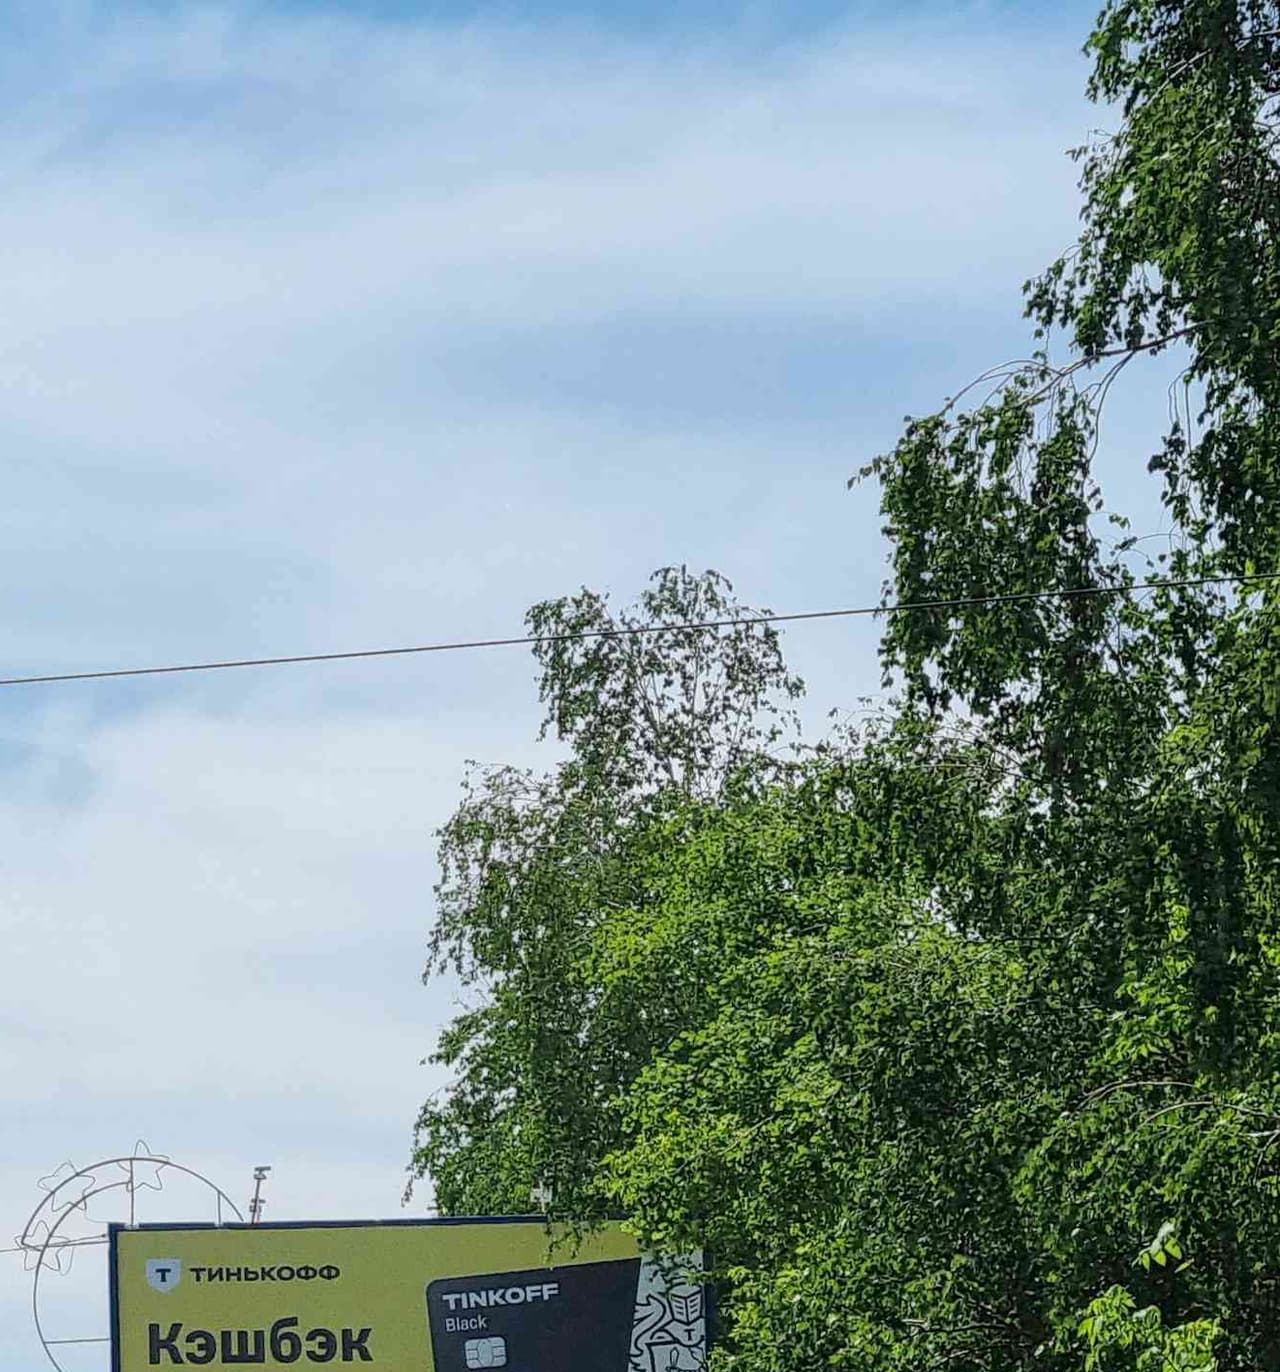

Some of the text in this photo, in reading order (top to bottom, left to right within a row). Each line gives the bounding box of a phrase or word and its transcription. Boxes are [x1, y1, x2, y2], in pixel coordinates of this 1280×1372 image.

[189, 1265, 341, 1283] ТИНЬКОФФ
[442, 1283, 560, 1310] TINKOFF
[445, 1314, 488, 1332] Black
[148, 1316, 374, 1365] Кэшбэк
